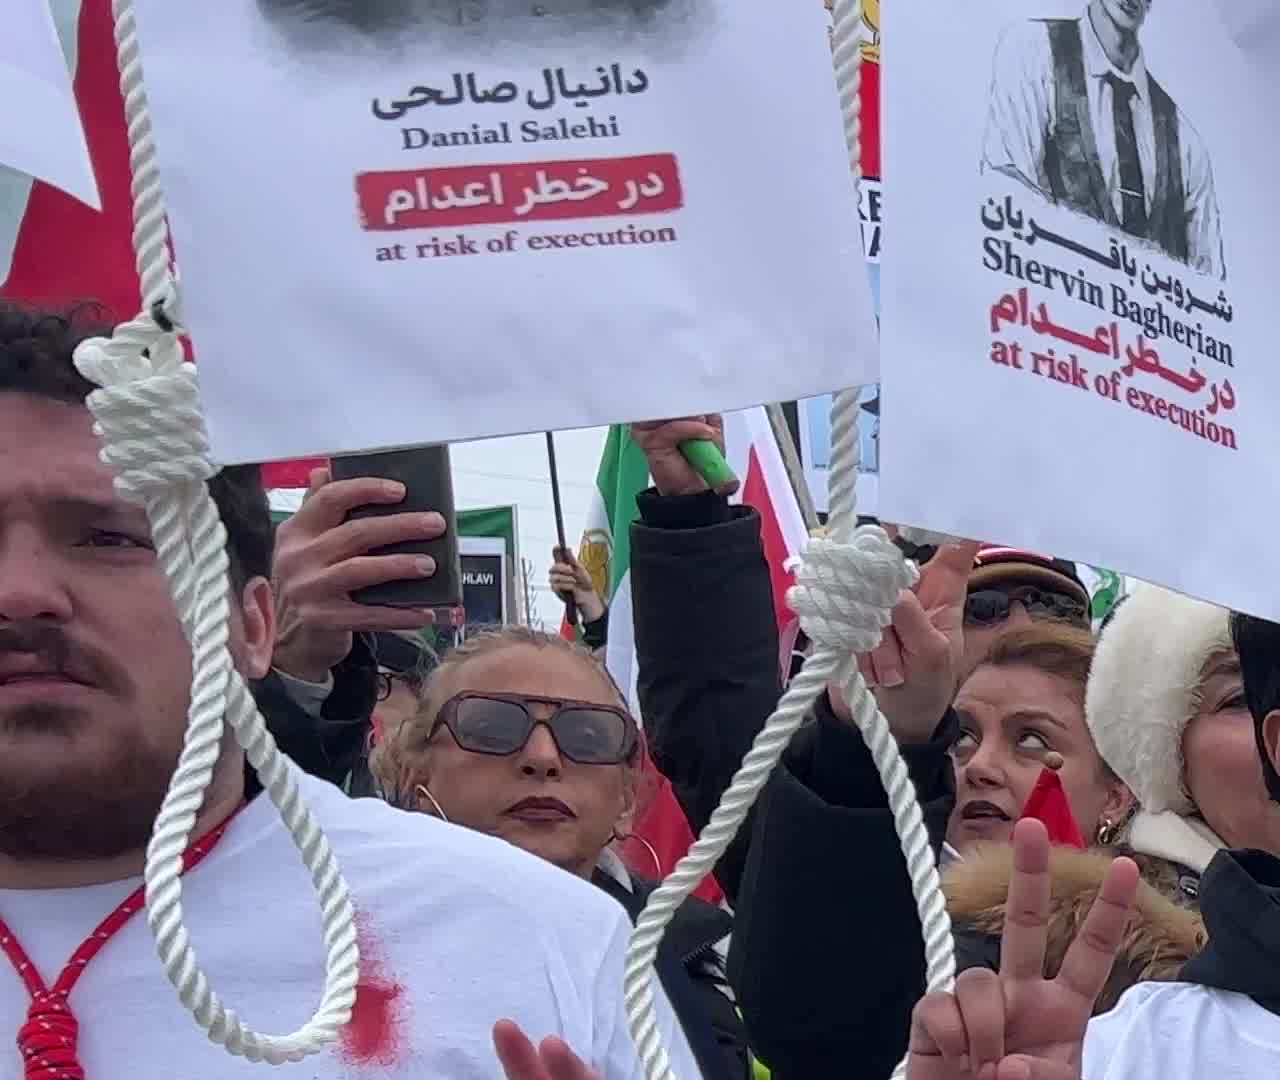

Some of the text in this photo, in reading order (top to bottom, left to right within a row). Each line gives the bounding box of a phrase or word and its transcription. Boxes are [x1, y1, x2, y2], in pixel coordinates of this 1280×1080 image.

[370, 62, 649, 121] دانیال صالحی
[400, 115, 620, 150] Danial Salehi
[383, 167, 665, 225] در خطر اعدام
[375, 223, 678, 263] at risk of execution
[982, 235, 1235, 368] Shervin Bagherian
[989, 339, 1239, 451] at risk of execution
